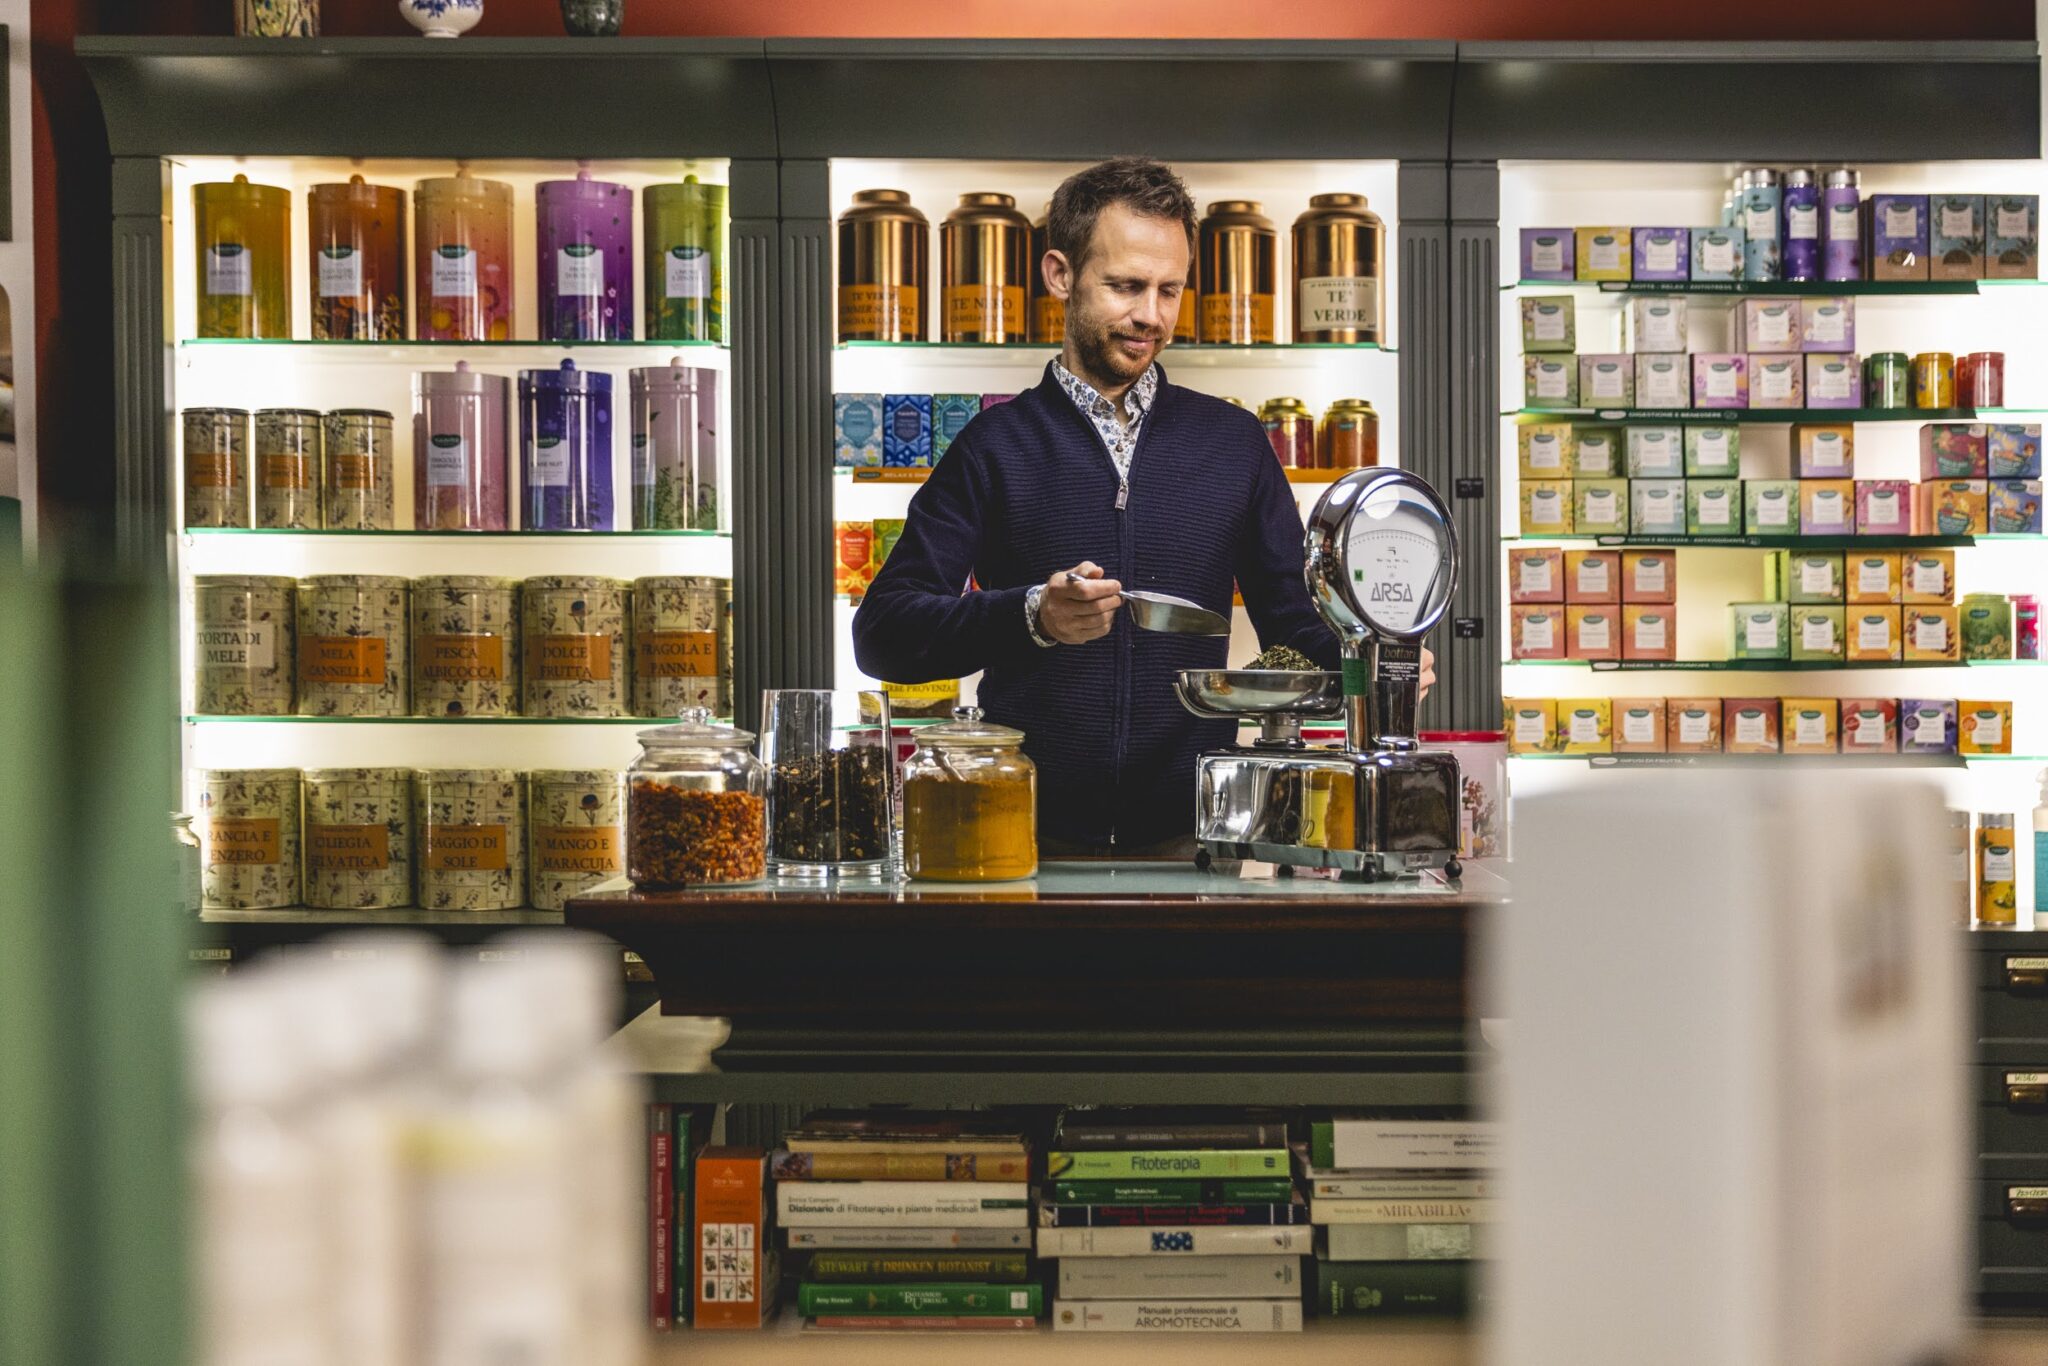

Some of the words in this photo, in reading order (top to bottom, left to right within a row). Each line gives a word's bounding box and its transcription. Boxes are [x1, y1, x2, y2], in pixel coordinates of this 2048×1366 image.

[1314, 309, 1366, 322] VERDE
[1371, 582, 1414, 602] ARSA
[197, 632, 241, 646] TORTA
[245, 632, 261, 646] DI
[320, 649, 355, 660] MELA
[434, 647, 478, 660] PESCA
[542, 647, 588, 659] DOLCE
[704, 643, 712, 656] E
[207, 650, 247, 663] MELE
[422, 666, 497, 679] ALBICOCCA
[540, 666, 592, 679] FRUTTA
[650, 662, 697, 675] PANNA
[207, 830, 258, 842] RANCIA
[263, 830, 271, 842] E
[483, 837, 497, 849] DI
[545, 838, 598, 850] MANGO
[601, 838, 609, 850] E
[210, 849, 266, 862] ENZERO
[443, 856, 478, 868] SOLE
[1131, 1156, 1201, 1171] Fitoterapia
[788, 1203, 834, 1213] Dizionario
[837, 1203, 845, 1213] di
[848, 1204, 895, 1215] Fitoterapia
[905, 1204, 933, 1215] piante
[935, 1203, 979, 1213] medicinali
[1384, 1204, 1466, 1217] MIRABILIA
[818, 1260, 868, 1274] STEWART
[883, 1260, 934, 1274] DRUNKEN
[938, 1260, 991, 1274] BOTANIST
[1138, 1306, 1172, 1314] Manuale
[1174, 1305, 1227, 1317] professionale
[1229, 1305, 1238, 1314] di
[1135, 1317, 1242, 1328] AROMOTECNICA
